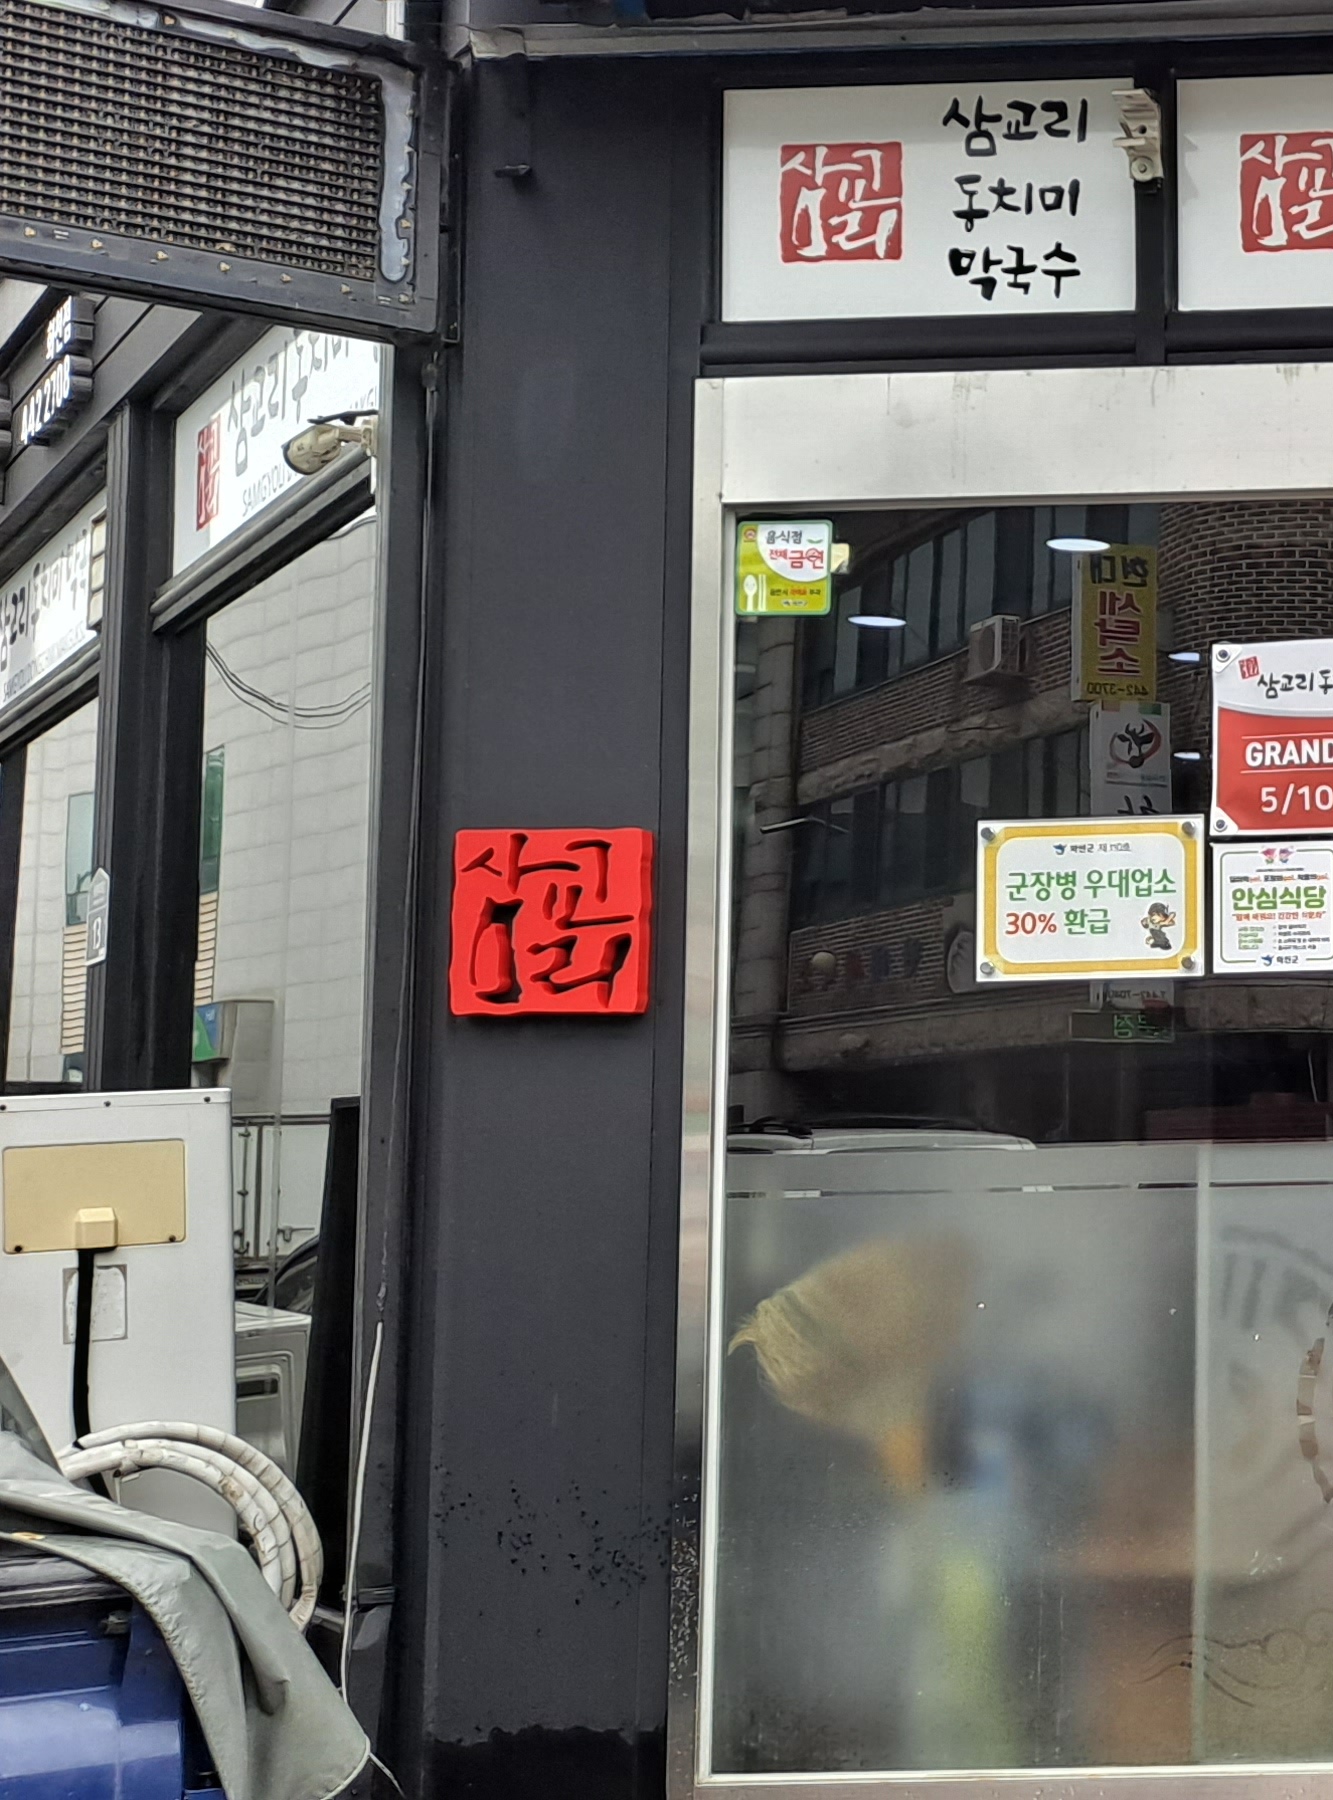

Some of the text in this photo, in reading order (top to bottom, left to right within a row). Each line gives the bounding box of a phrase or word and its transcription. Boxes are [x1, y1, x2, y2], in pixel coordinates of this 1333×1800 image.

[942, 97, 1089, 156] 삼교리
[952, 175, 1080, 232] 동치미
[948, 242, 1080, 300] 막국수
[227, 340, 288, 477] 삼교리
[766, 530, 802, 544] 음식점
[1257, 670, 1314, 699] 삼교리
[1261, 784, 1333, 815] 5/10
[1006, 868, 1177, 901] 군장병 우대업소
[1232, 885, 1327, 911] 안심식당
[1006, 908, 1111, 935] 30% 환급
